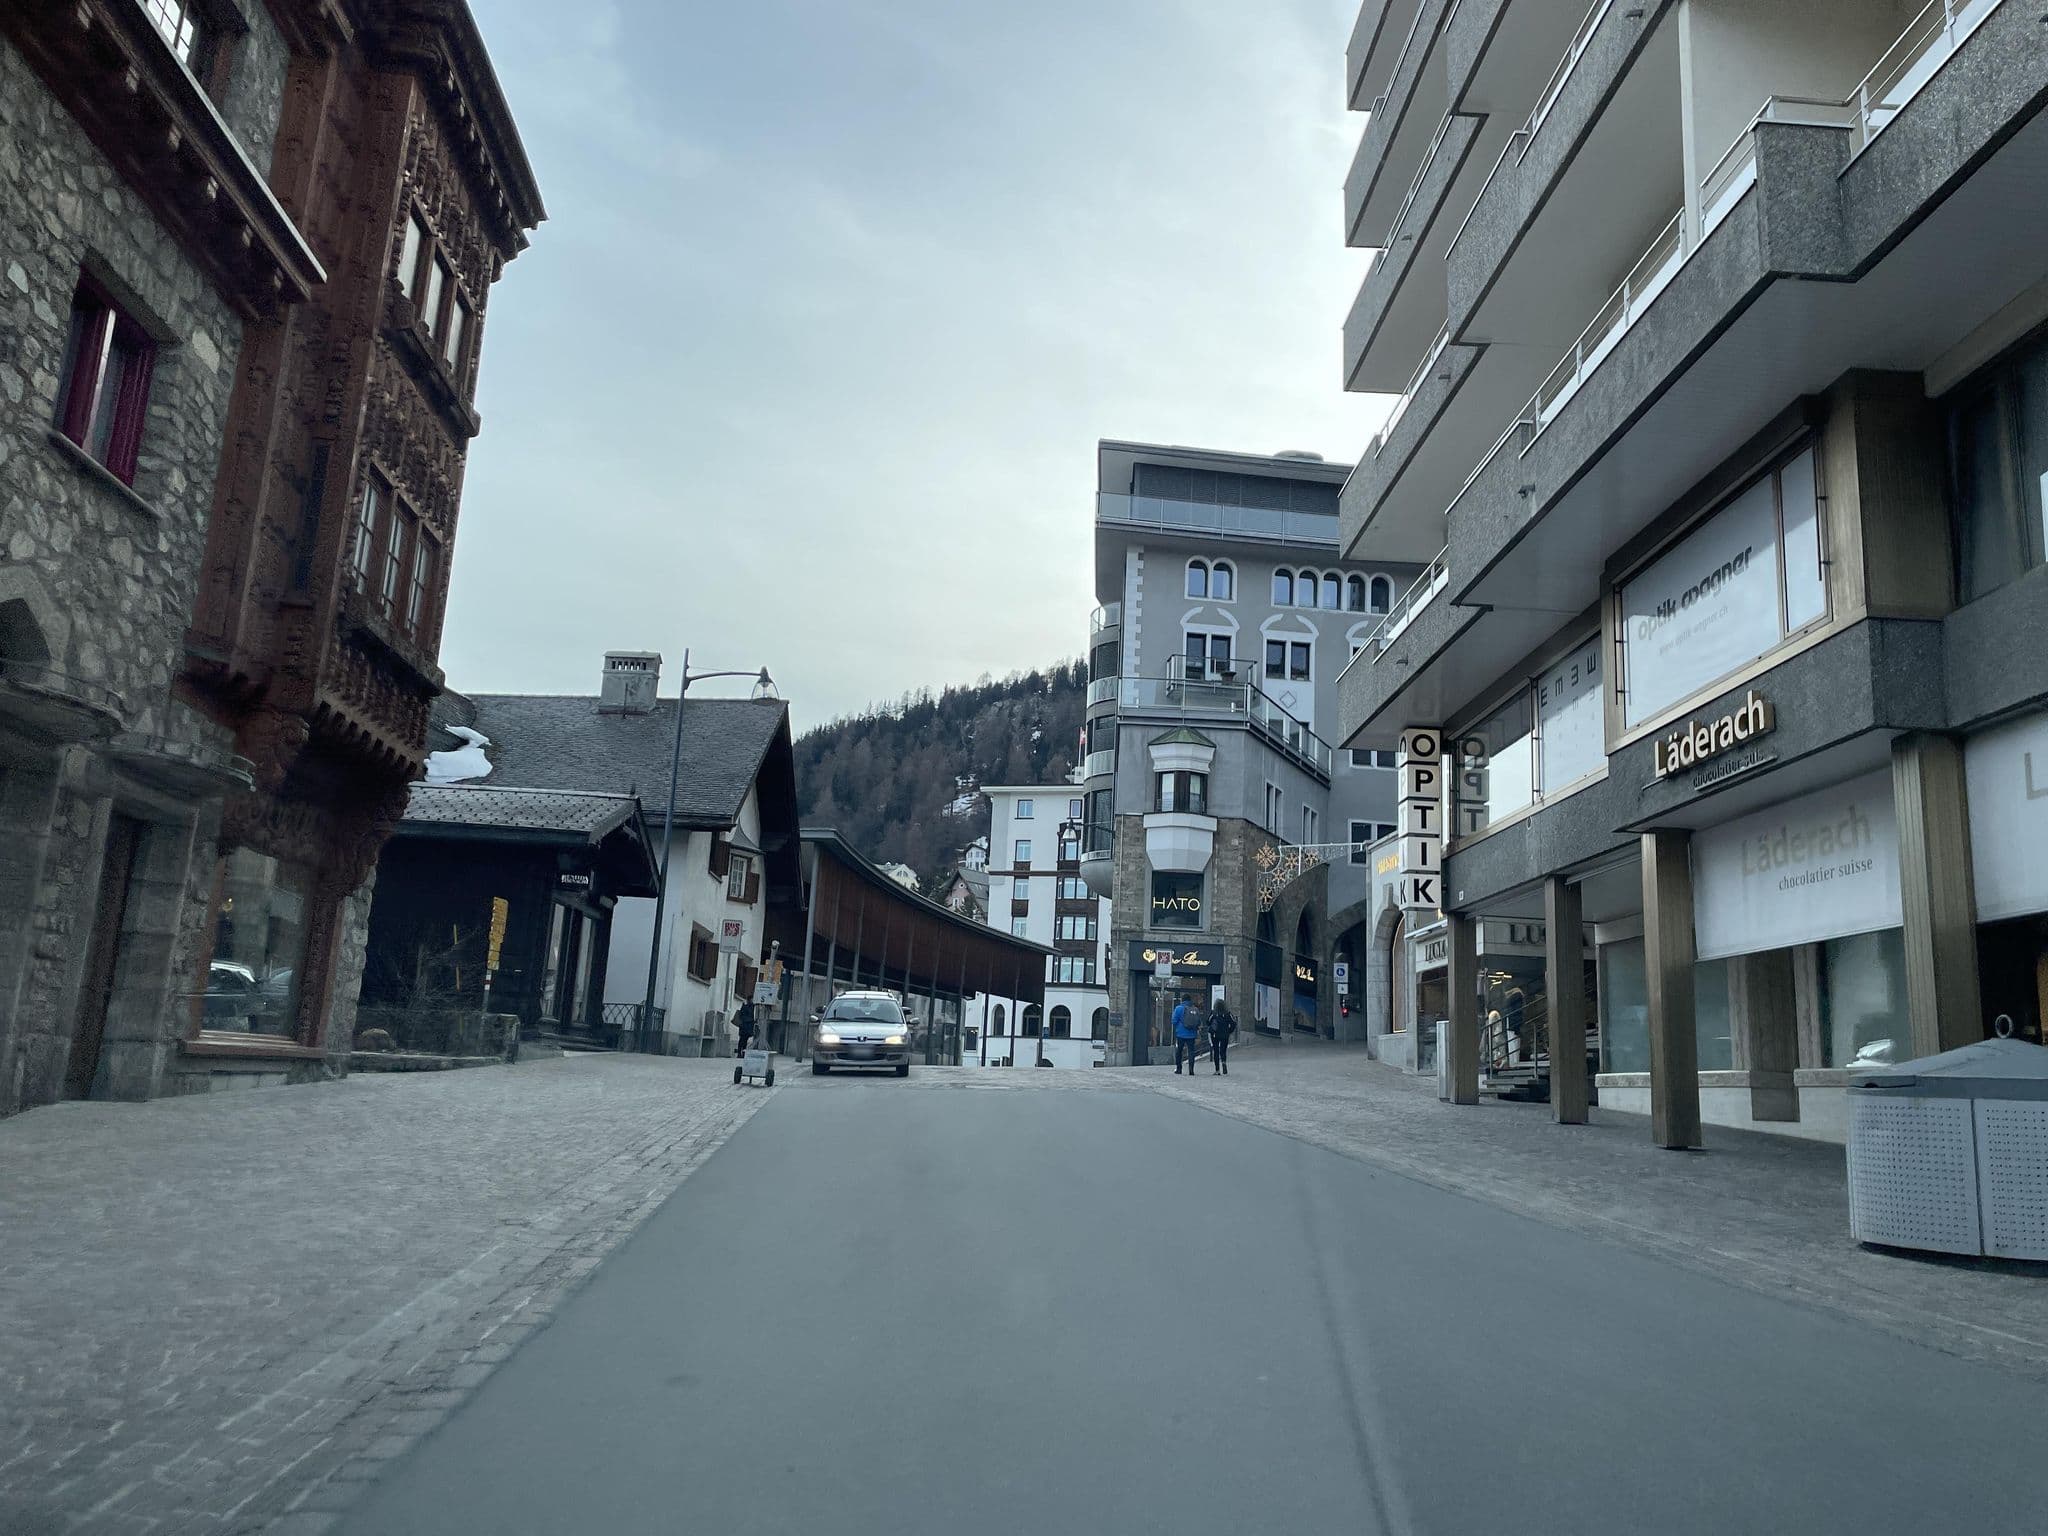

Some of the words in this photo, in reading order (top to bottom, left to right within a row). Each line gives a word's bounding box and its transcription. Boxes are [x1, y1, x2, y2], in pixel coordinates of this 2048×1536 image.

[1654, 689, 1766, 778] Läderach
[1411, 733, 1436, 905] OPTIK
[1741, 804, 1872, 877] Läderach
[1153, 897, 1200, 911] HATO
[1778, 866, 1835, 891] chocolatier
[1838, 858, 1873, 878] suisse
